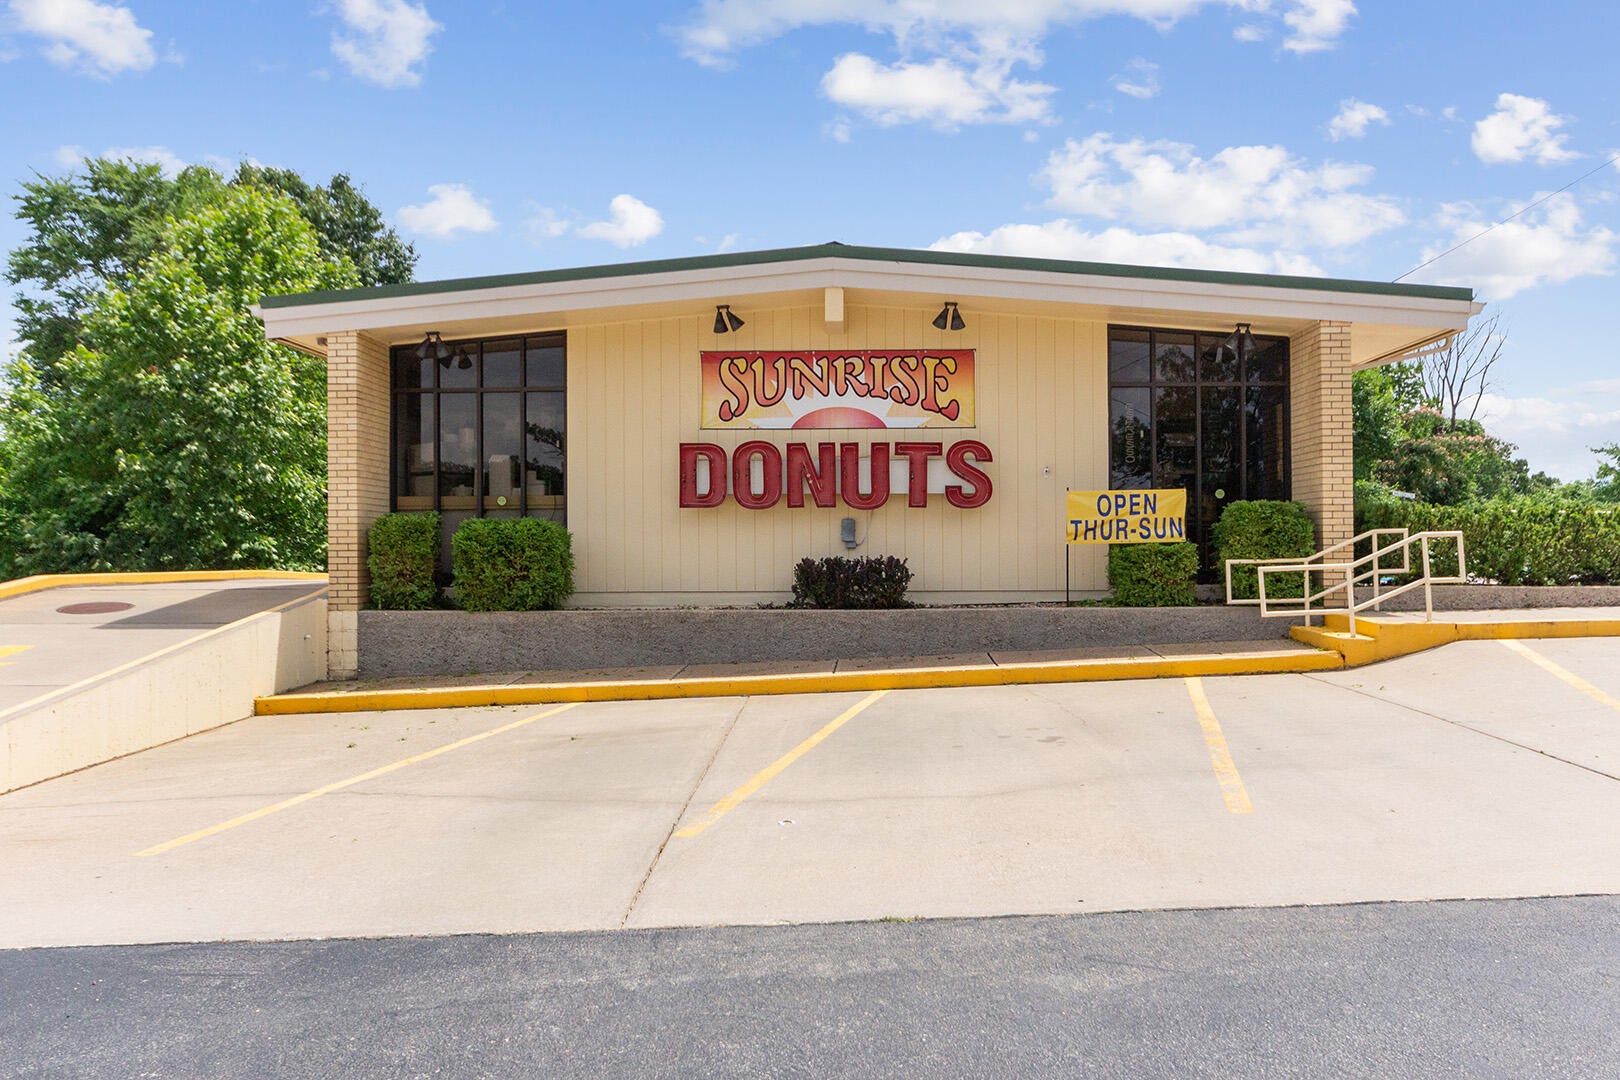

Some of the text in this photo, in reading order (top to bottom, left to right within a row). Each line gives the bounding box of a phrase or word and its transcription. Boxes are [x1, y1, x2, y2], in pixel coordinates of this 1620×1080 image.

[718, 355, 960, 422] SUNRISE
[679, 440, 993, 510] DONUTS
[1097, 493, 1157, 517] OPEN
[1070, 517, 1183, 541] THUR-SUN
